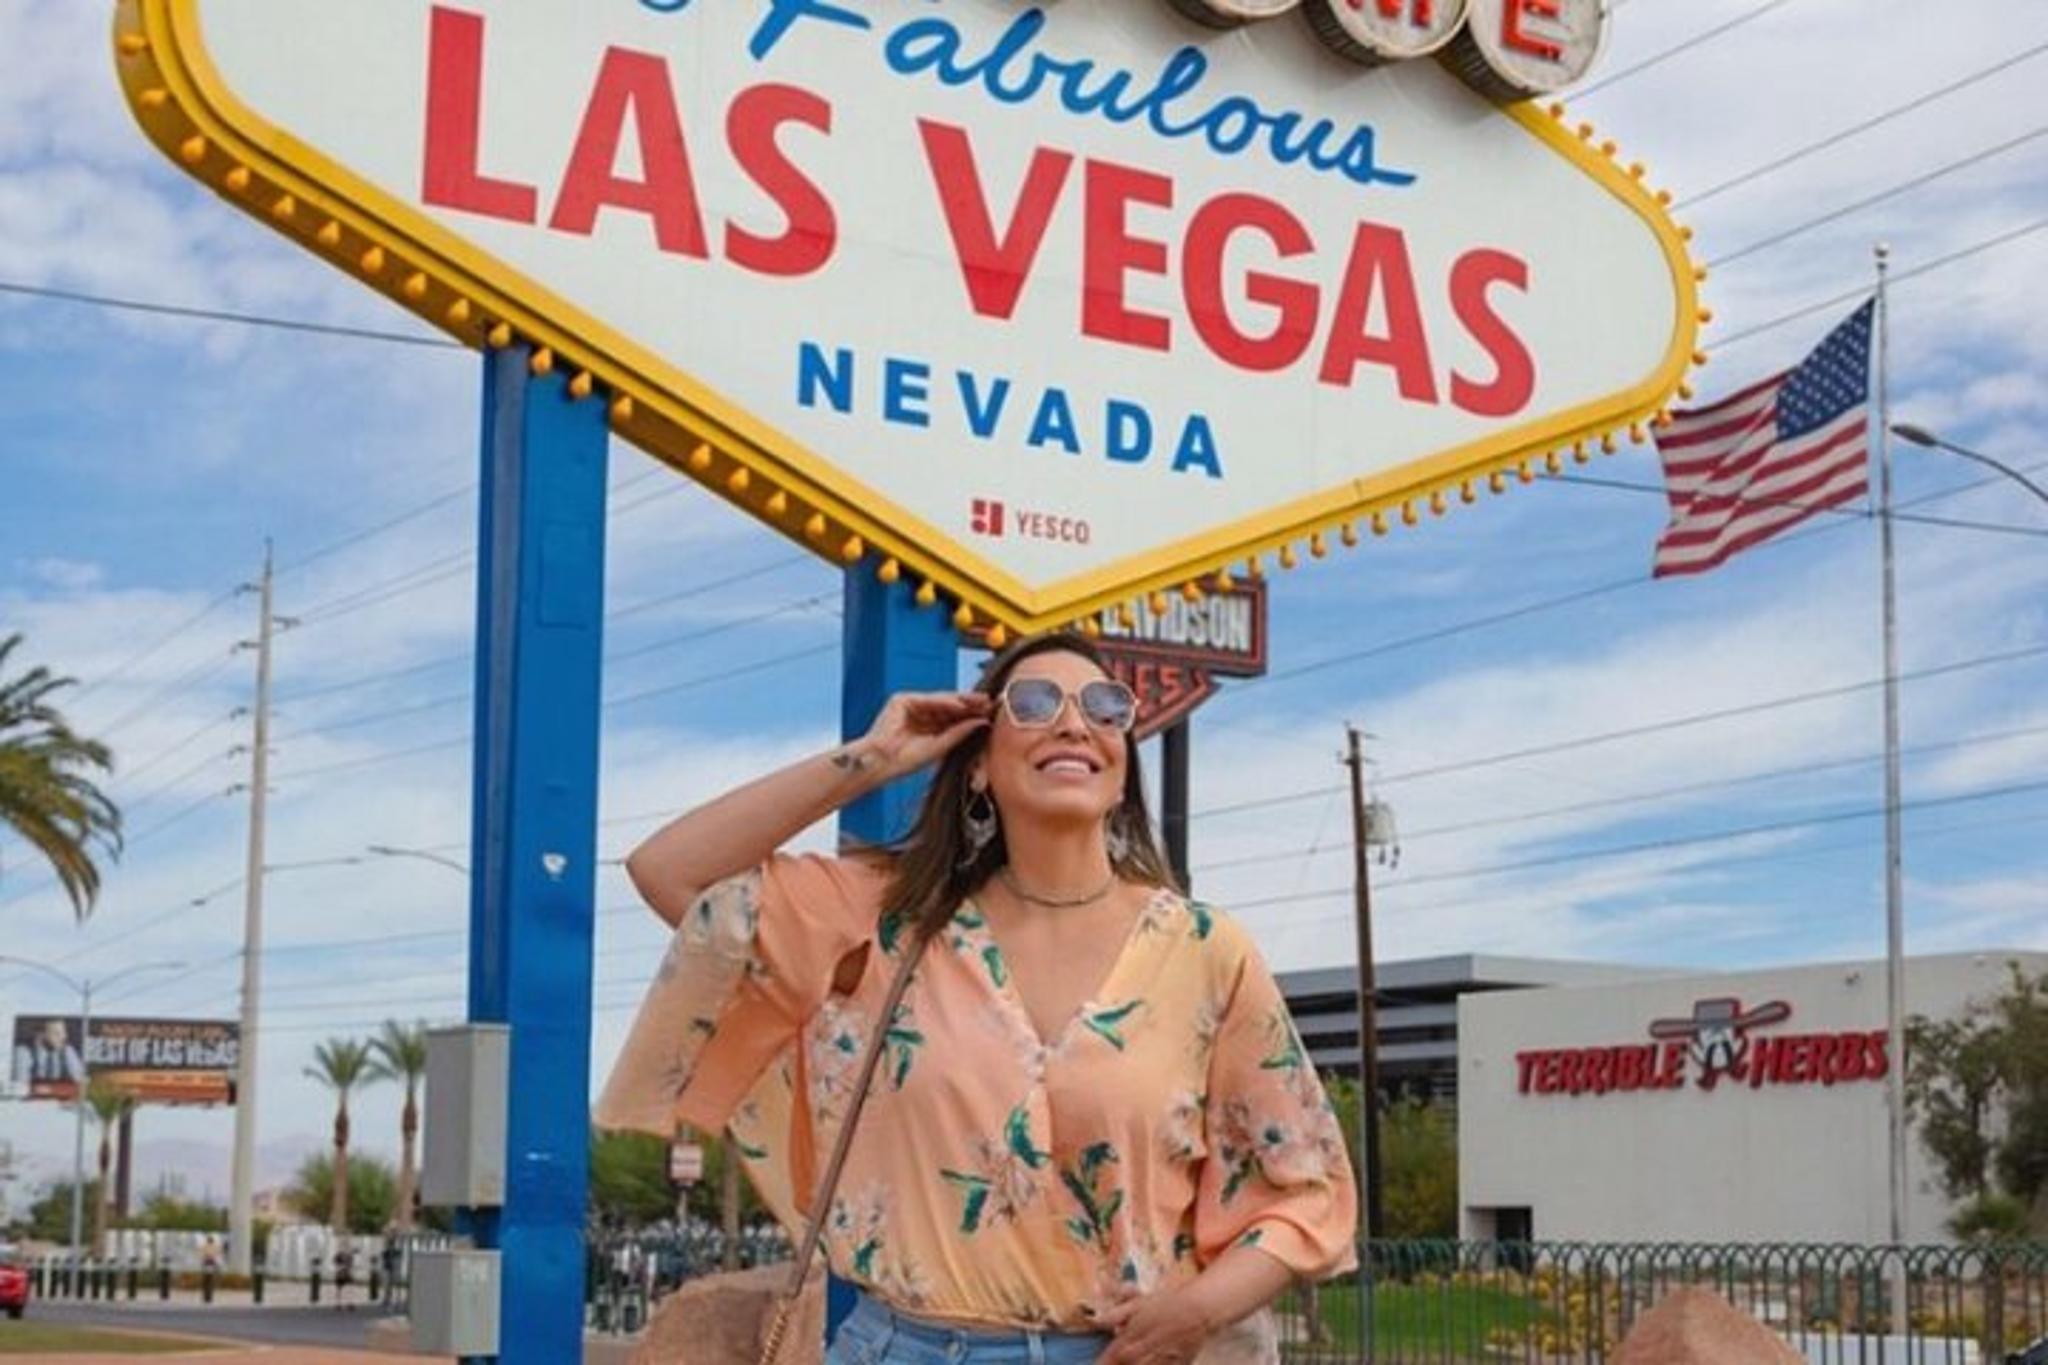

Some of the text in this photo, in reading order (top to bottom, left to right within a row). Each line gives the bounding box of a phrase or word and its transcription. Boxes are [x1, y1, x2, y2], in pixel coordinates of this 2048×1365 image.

[421, 7, 1534, 418] LAS VEGAS
[795, 340, 1224, 478] NEVADA
[1016, 509, 1090, 544] YESCO
[87, 1037, 238, 1067] BEST OF LAS VEGAS
[1515, 1029, 1890, 1096] TERRIBLE HERBS
